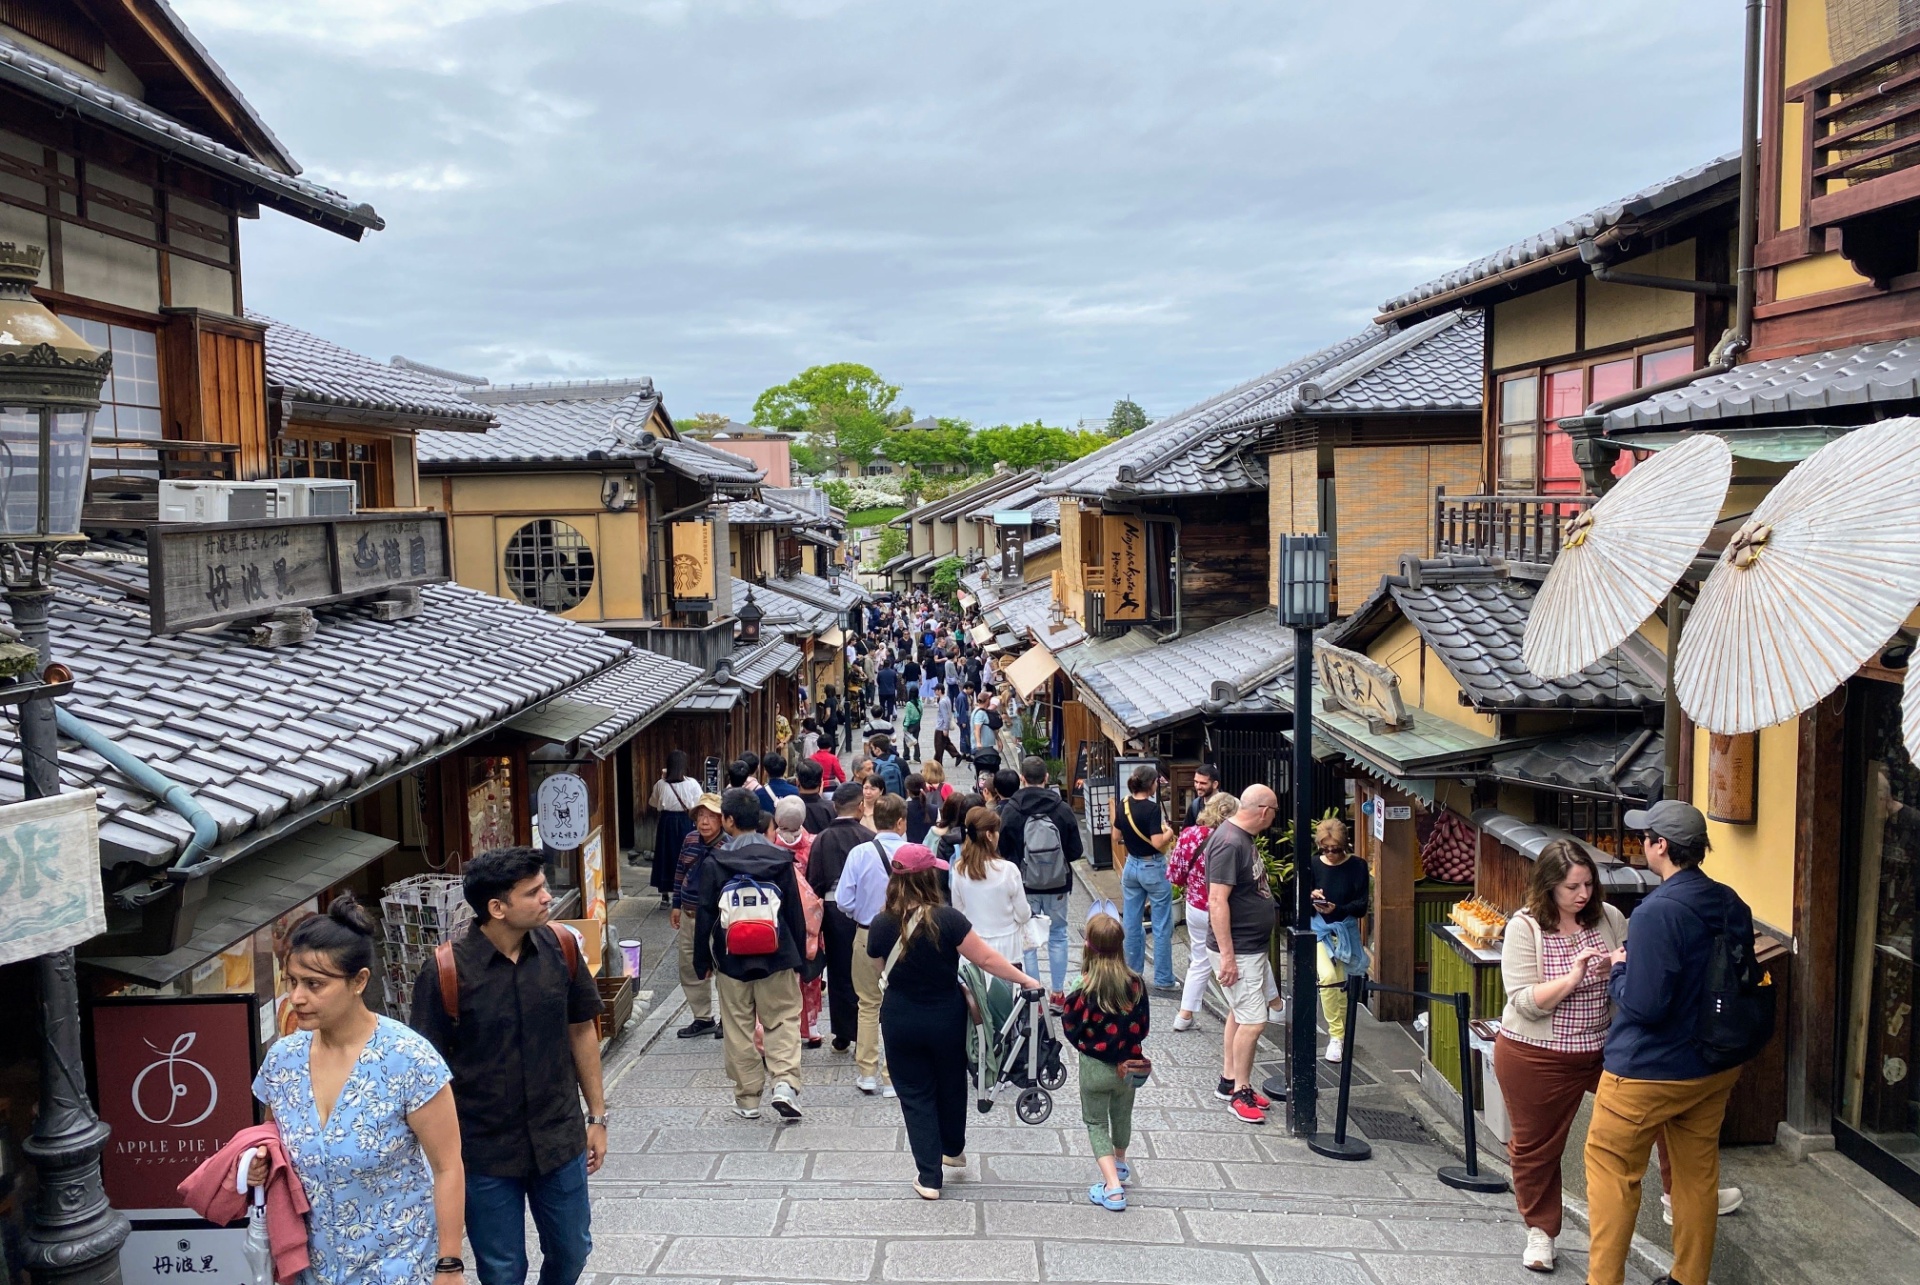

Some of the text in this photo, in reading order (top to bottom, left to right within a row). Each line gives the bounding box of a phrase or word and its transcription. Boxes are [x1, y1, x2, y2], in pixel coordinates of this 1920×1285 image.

[205, 556, 296, 613] 丹波黒
[550, 831, 578, 839] どら焼き
[115, 1140, 169, 1154] APPLE
[178, 1138, 206, 1152] PIE
[152, 1254, 219, 1275] 丹波黒
